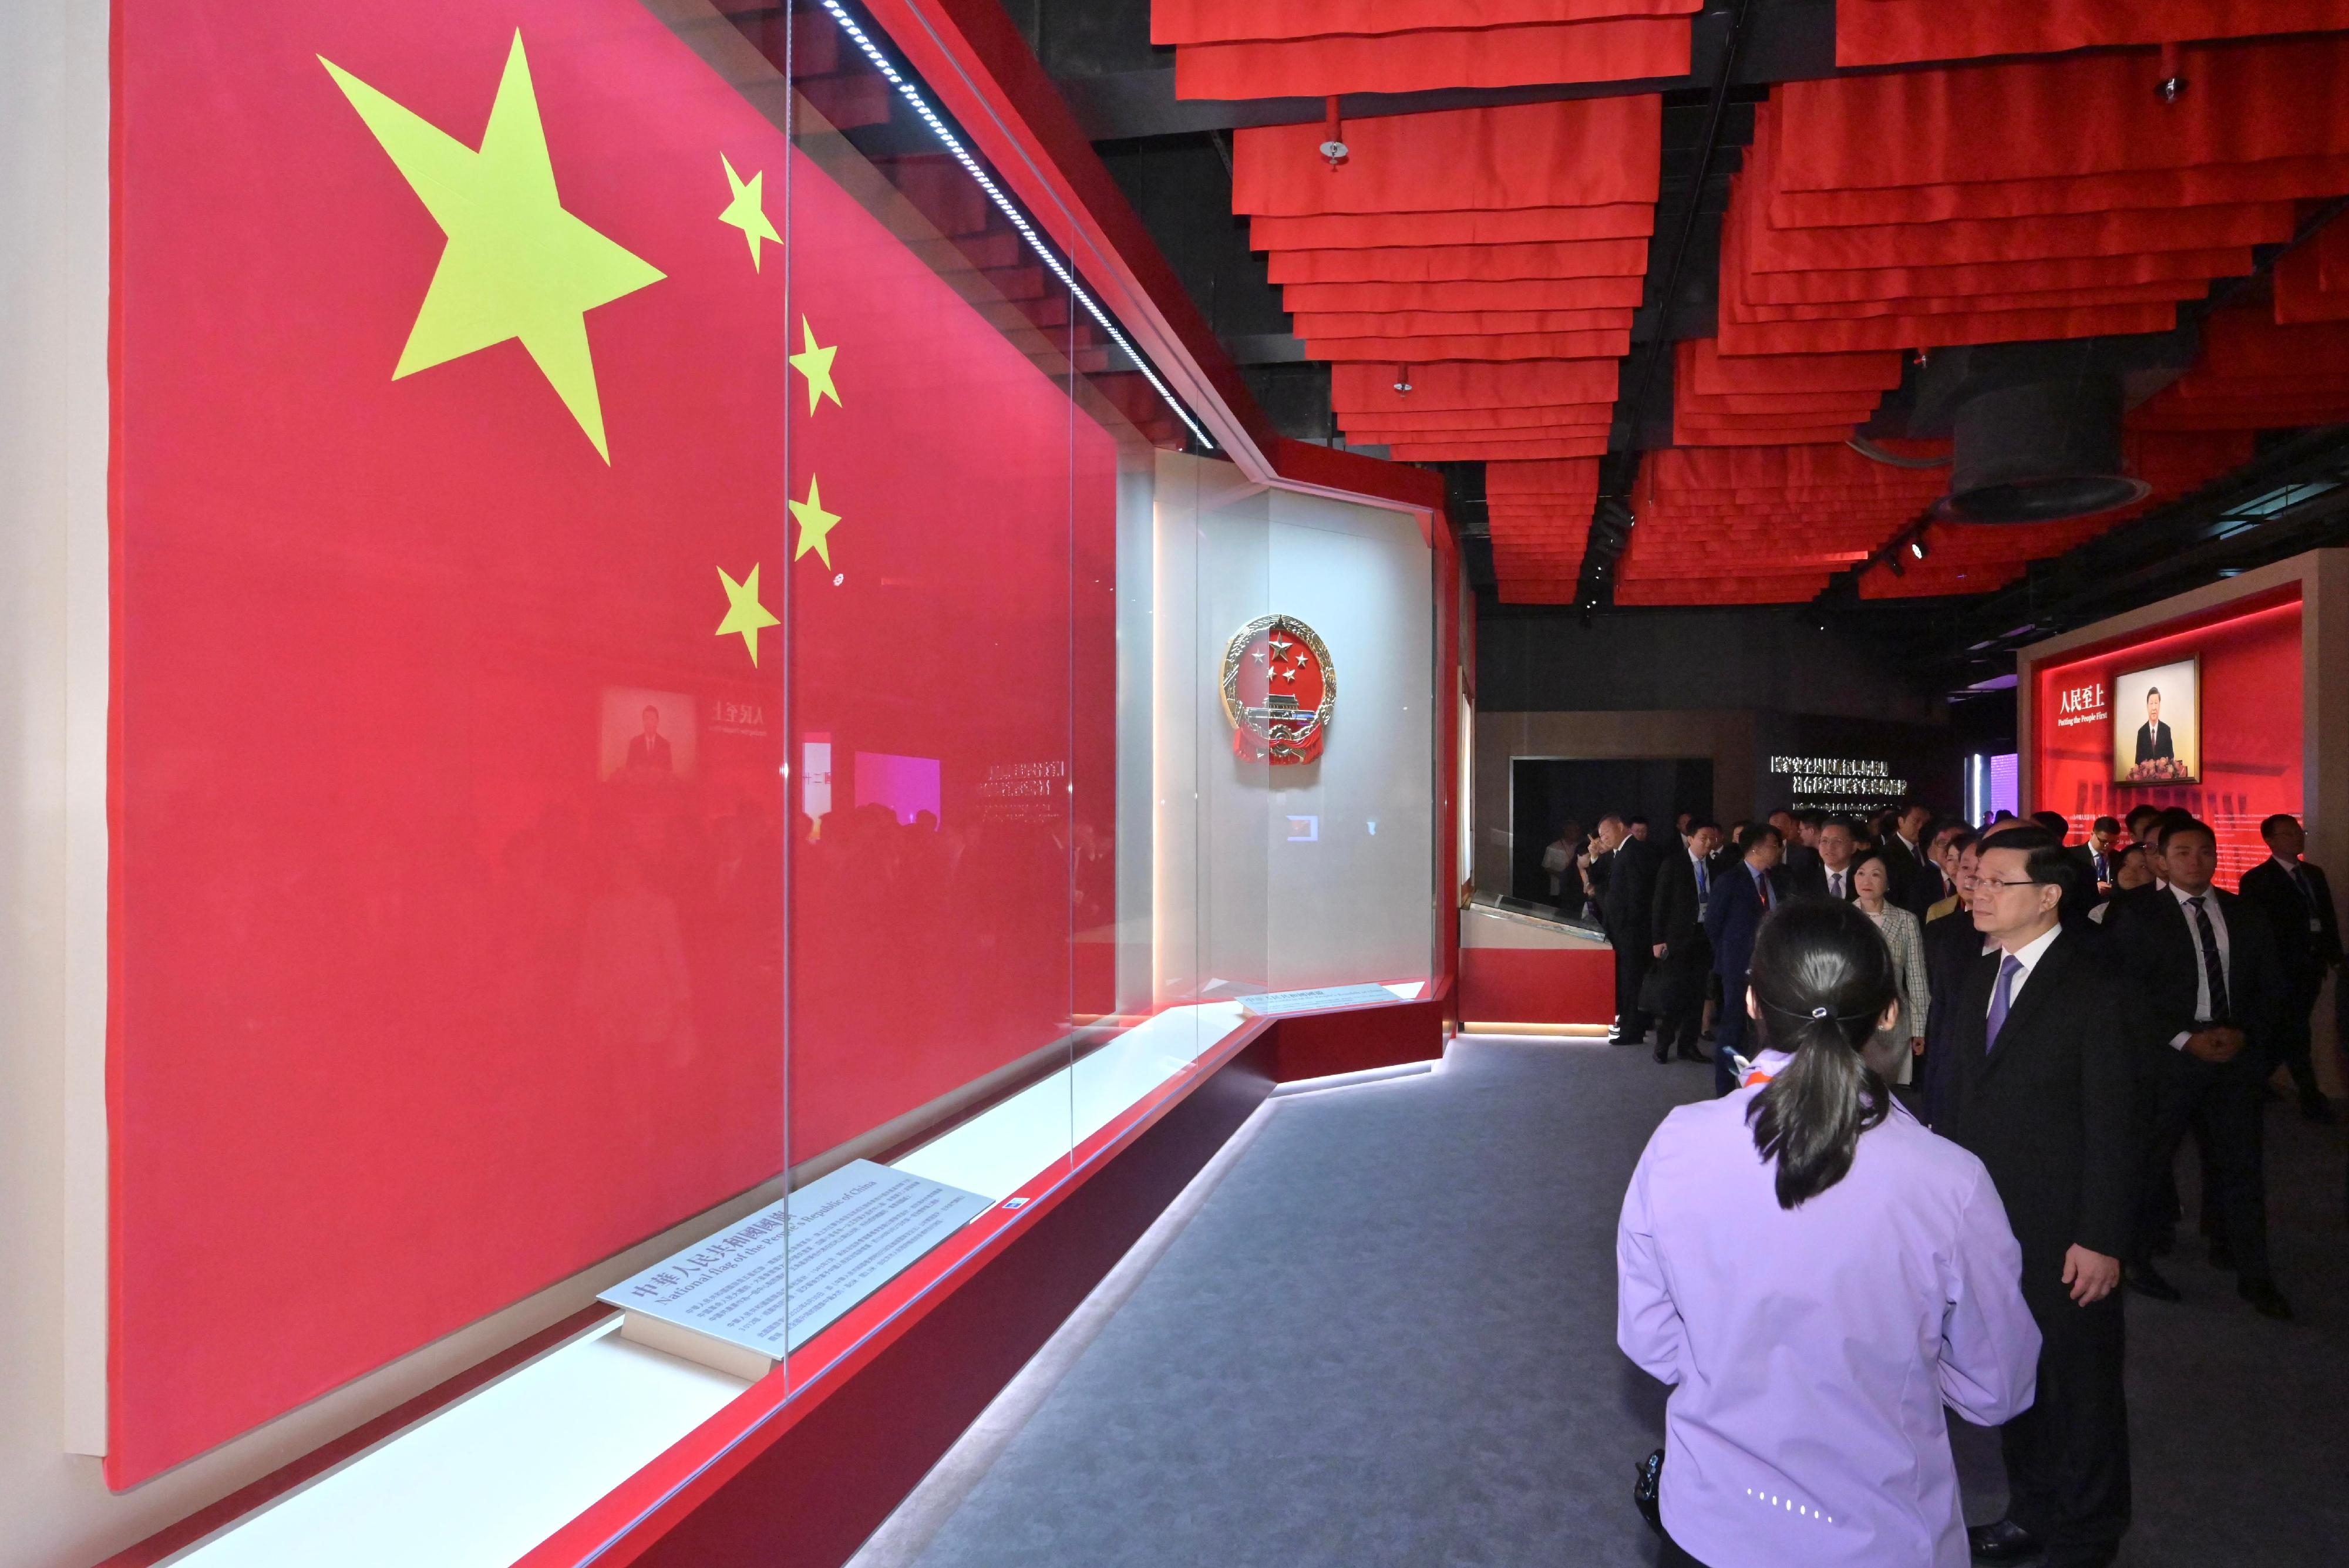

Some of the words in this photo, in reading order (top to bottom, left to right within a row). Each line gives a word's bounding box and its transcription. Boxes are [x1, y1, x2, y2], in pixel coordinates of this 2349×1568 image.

[2059, 684, 2105, 715] 人民至上
[2081, 713, 2096, 723] People
[2096, 712, 2107, 720] First
[632, 1210, 797, 1297] 中華人民共和國國旗
[654, 1273, 713, 1305] National
[708, 1261, 738, 1276] flag
[733, 1253, 748, 1263] of
[745, 1242, 766, 1256] the
[800, 1198, 844, 1223] Republic
[842, 1192, 853, 1201] of
[850, 1180, 877, 1196] China
